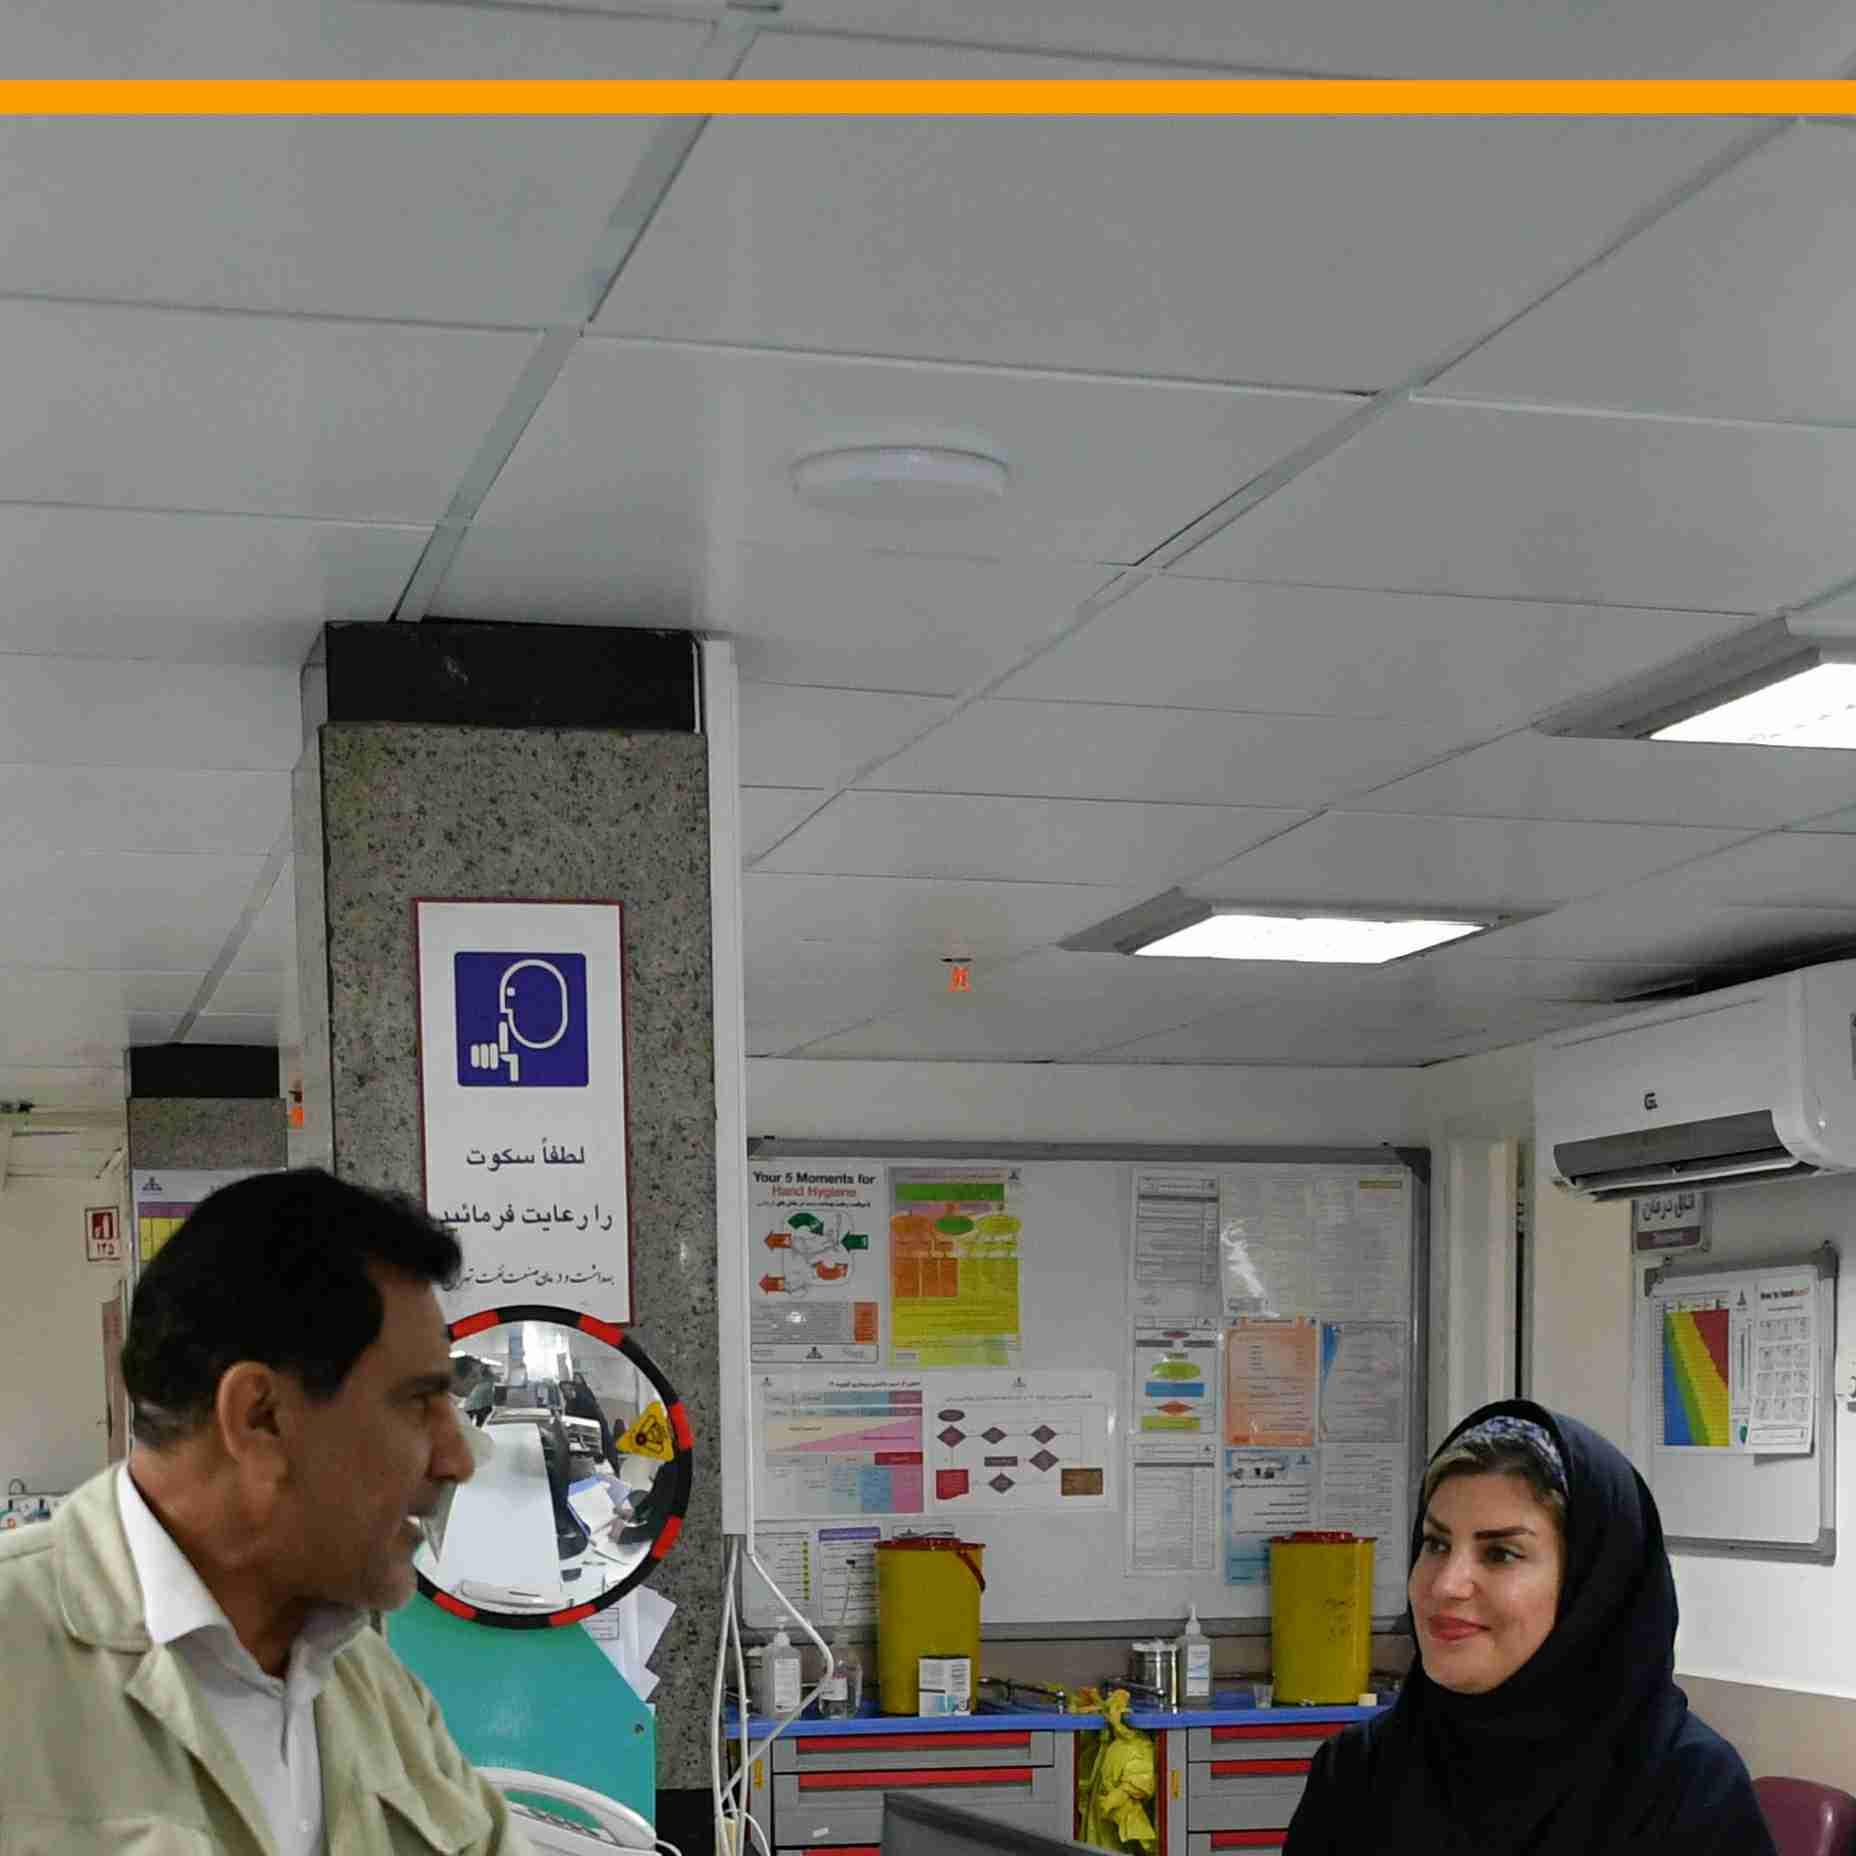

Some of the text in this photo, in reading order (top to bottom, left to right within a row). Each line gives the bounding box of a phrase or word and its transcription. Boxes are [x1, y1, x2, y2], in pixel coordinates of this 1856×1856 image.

[466, 1137, 585, 1172] لطفاً سکوت
[752, 1171, 876, 1185] Your 5 Moments for
[521, 1203, 589, 1231] رعایت
[595, 1204, 613, 1231] را
